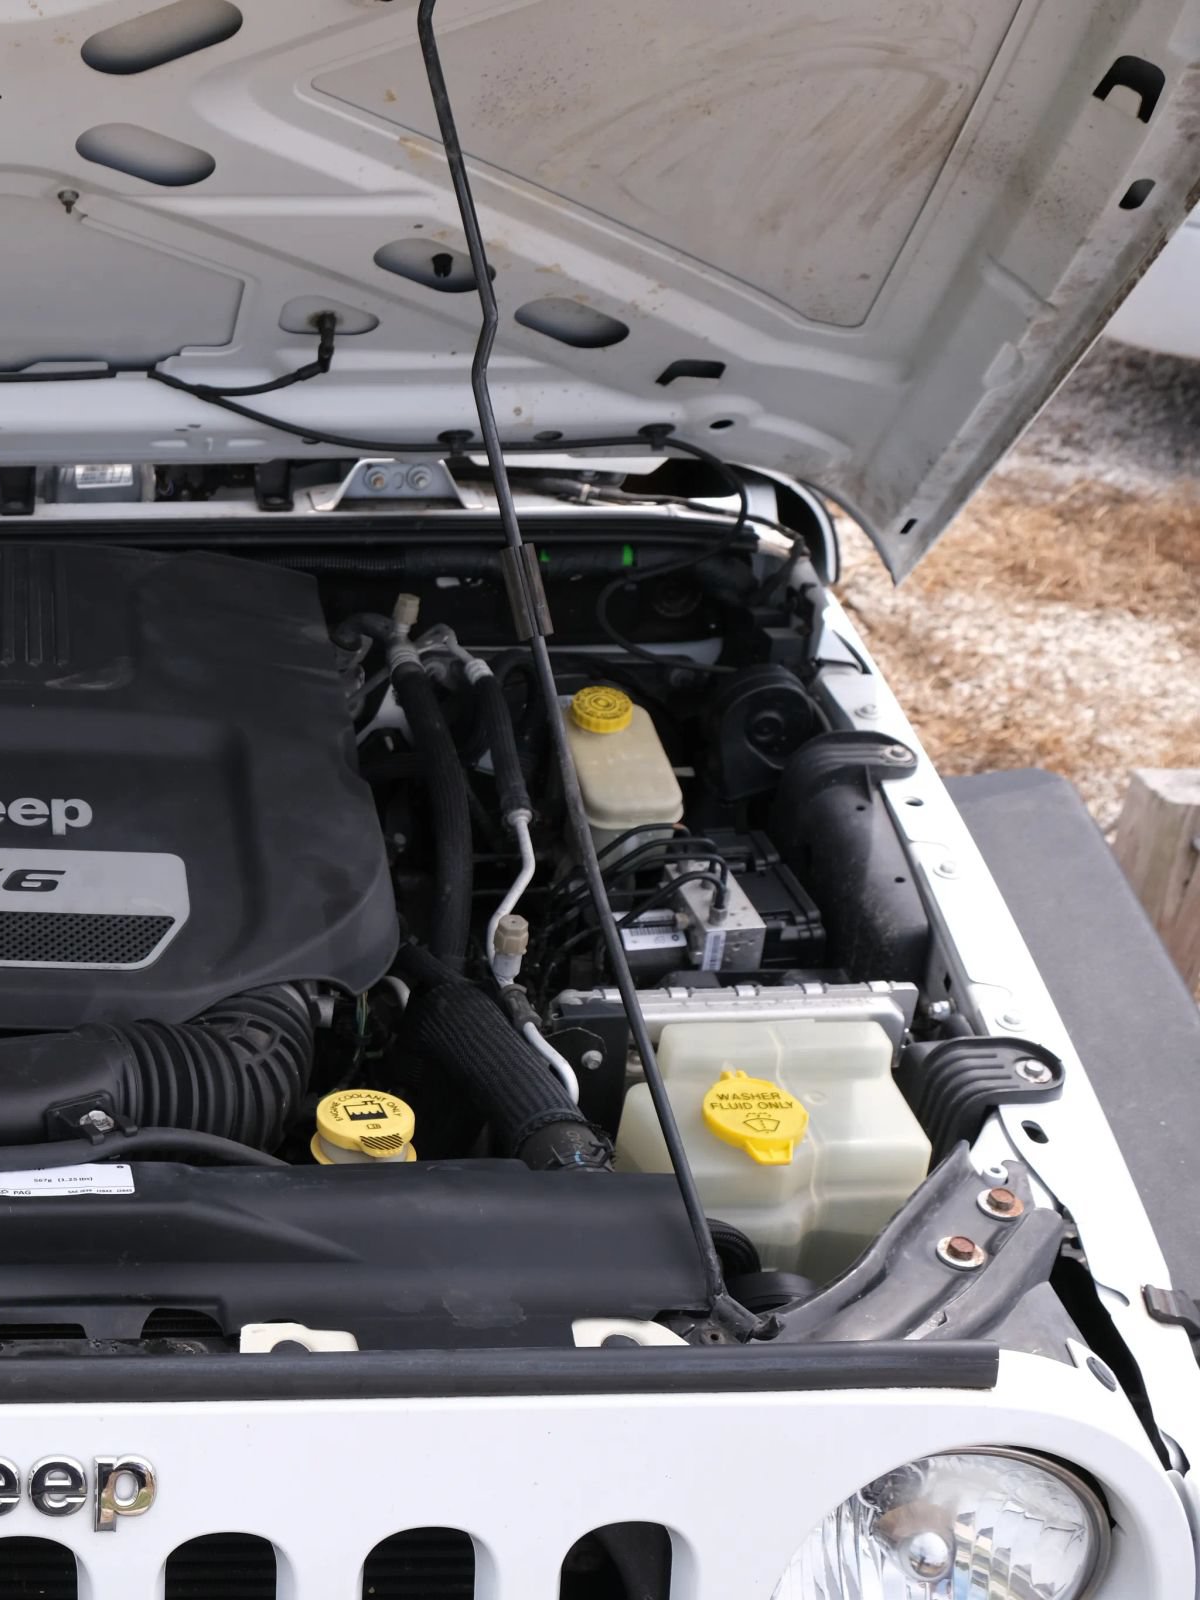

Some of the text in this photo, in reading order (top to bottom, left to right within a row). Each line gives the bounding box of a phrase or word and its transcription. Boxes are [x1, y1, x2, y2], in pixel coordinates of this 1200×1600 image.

[716, 1092, 781, 1101] WASHER
[338, 1093, 386, 1102] COOLANT
[387, 1101, 403, 1117] ONLY
[710, 1101, 793, 1110] FLUID ONLY
